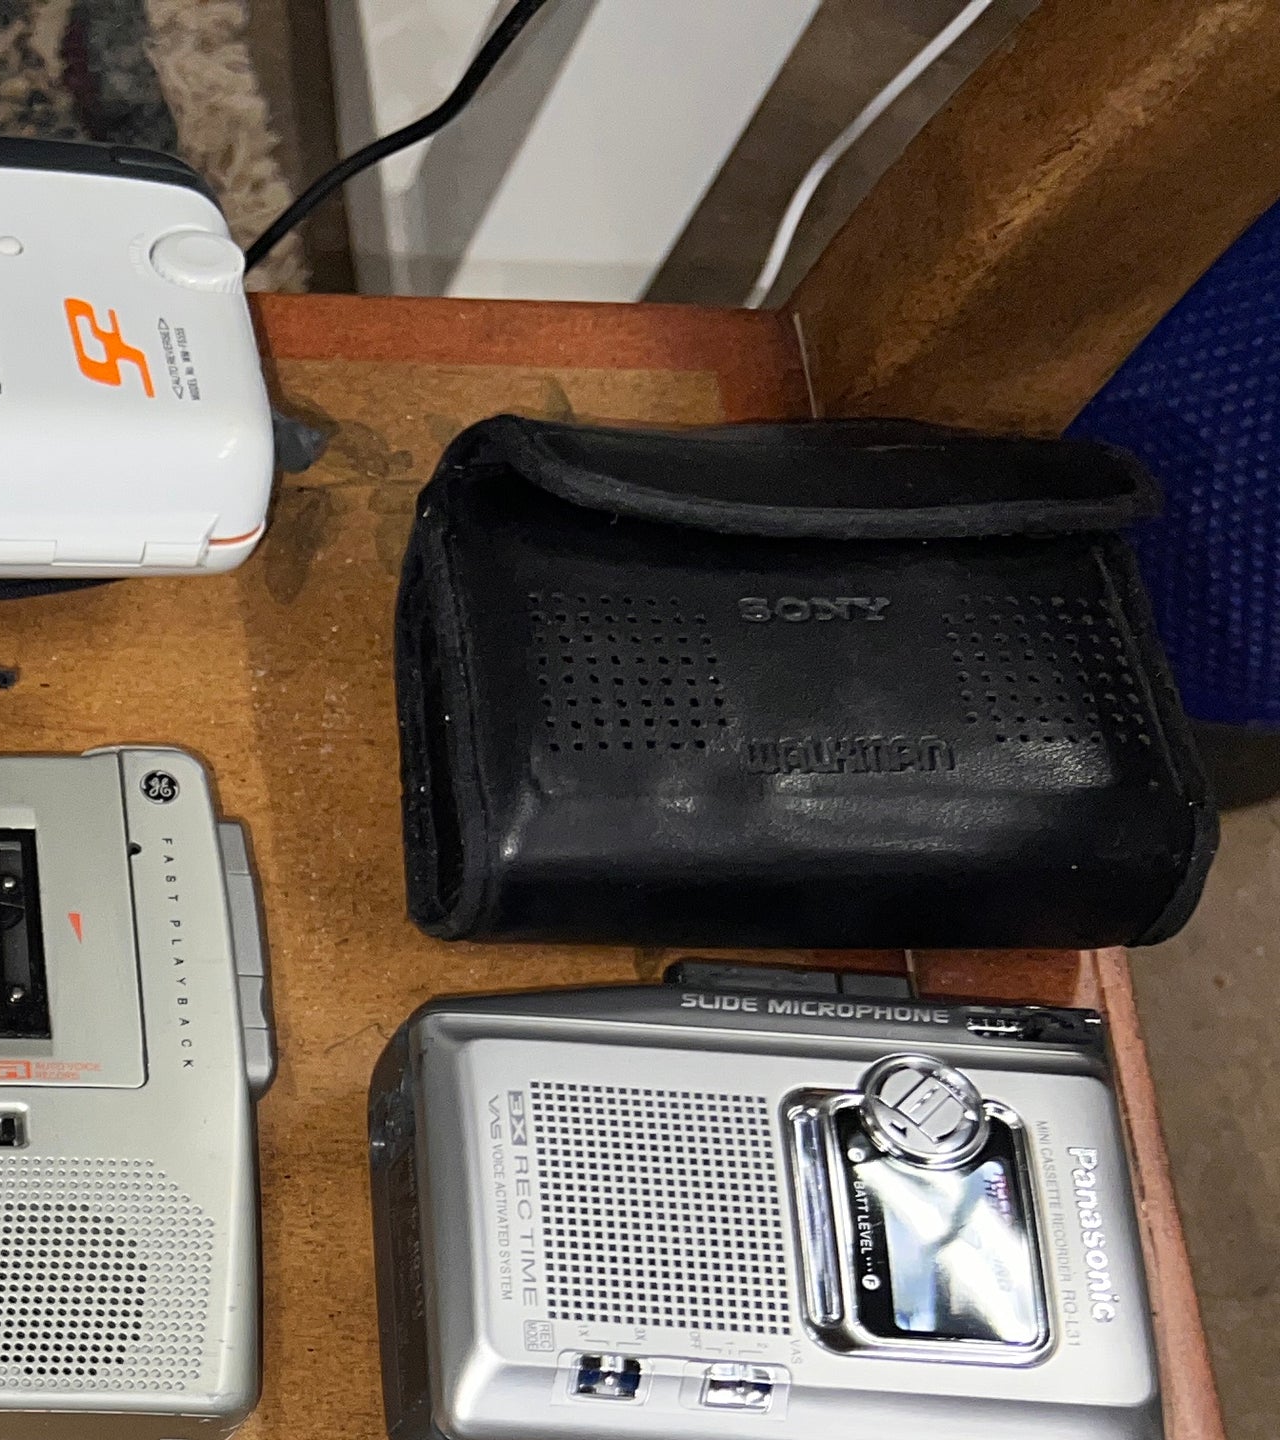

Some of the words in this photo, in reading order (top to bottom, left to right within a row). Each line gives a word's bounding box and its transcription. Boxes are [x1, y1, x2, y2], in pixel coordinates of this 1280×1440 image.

[737, 595, 891, 623] SONY
[743, 736, 958, 775] WALKMAN
[162, 836, 180, 903] FAST
[169, 918, 195, 1070] PLAYBACK
[681, 993, 758, 1013] SLIDE
[768, 999, 949, 1024] MICROPHONE
[488, 1094, 502, 1140] VAS
[1037, 1120, 1049, 1145] MINI
[492, 1144, 506, 1180] VOICE
[1039, 1147, 1061, 1211] CASSETTE
[514, 1155, 532, 1220] REC
[853, 1180, 868, 1212] BATT
[494, 1181, 510, 1248] ACTIVATED
[857, 1214, 873, 1254] LEVEL
[1067, 1146, 1121, 1324] Panasonic
[519, 1233, 538, 1307] TIME
[1048, 1213, 1072, 1282] RECORDER
[499, 1250, 513, 1300] SYSTEM
[538, 1323, 551, 1350] REC
[789, 1339, 802, 1365] VAS
